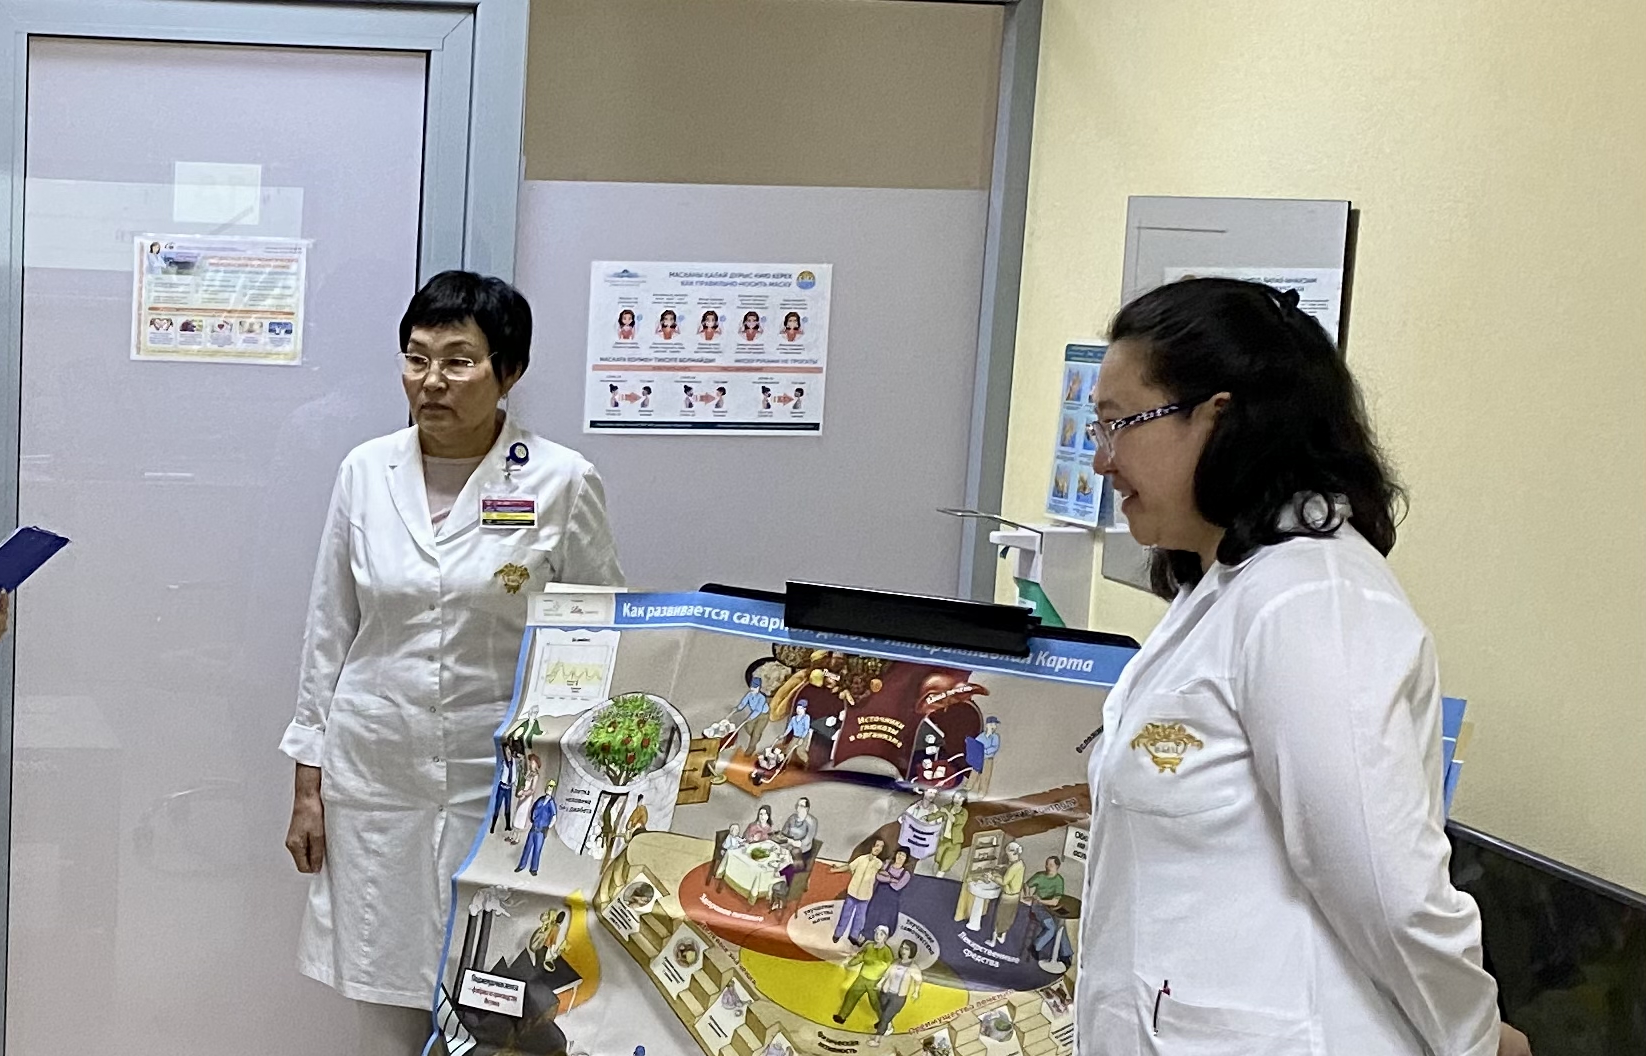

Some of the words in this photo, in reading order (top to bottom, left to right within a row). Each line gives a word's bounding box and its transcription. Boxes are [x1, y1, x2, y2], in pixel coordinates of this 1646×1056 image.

[622, 602, 645, 618] Как
[646, 603, 730, 622] развивается
[1035, 652, 1094, 674] Карта
